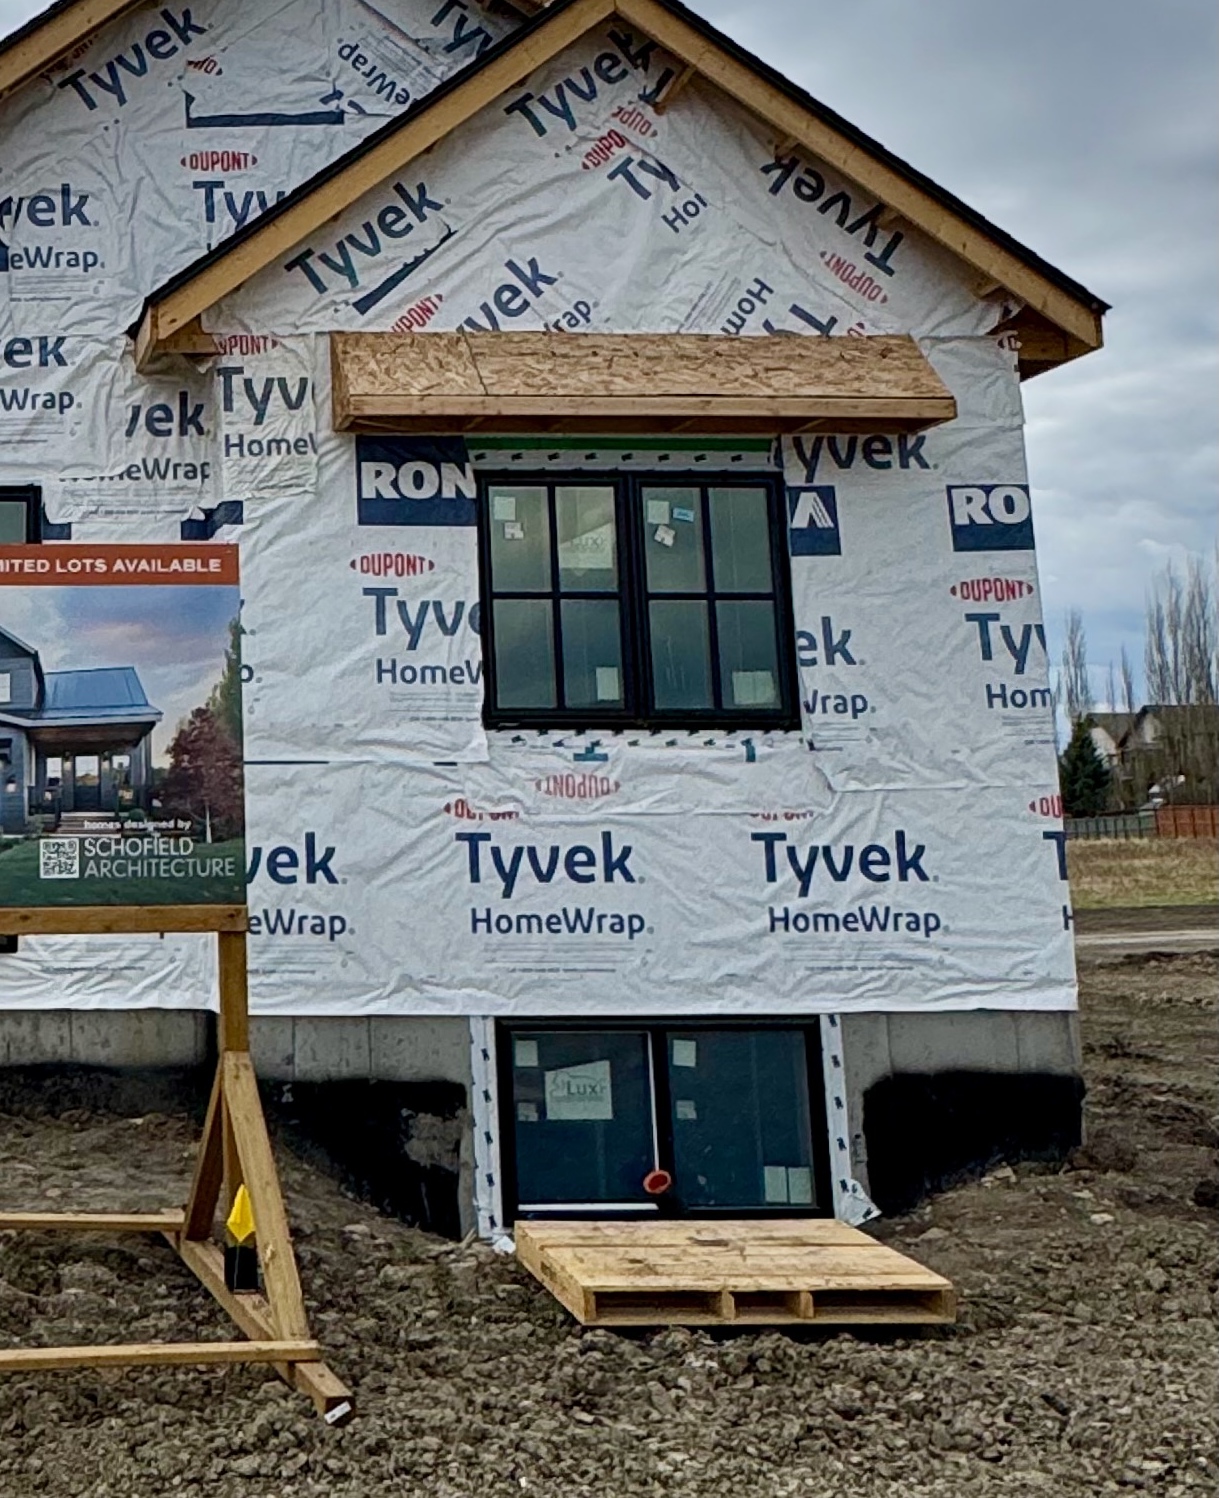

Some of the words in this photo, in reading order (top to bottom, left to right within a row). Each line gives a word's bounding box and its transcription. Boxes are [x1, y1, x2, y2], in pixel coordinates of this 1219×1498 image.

[58, 8, 208, 111] Tyvek
[504, 29, 646, 138] Tyvek
[190, 151, 249, 172] DUPONT
[760, 147, 904, 277] Tyvek
[284, 182, 444, 294] Tyvek
[824, 253, 883, 302] DUPONT
[456, 257, 558, 332] vek
[217, 366, 315, 426] Tyv
[55, 558, 107, 574] LOTS
[112, 558, 222, 574] AVAILABLE
[360, 553, 425, 577] DUPONT
[960, 578, 1025, 602] DUPONT
[544, 773, 611, 799] DUPONT
[123, 819, 175, 832] designed
[177, 819, 192, 831] by
[83, 836, 194, 857] SCHOFIELD
[83, 857, 236, 878] ARCHITECTURE
[455, 831, 636, 899] Tyvek
[751, 830, 930, 898] Tyvek
[470, 907, 646, 940] HomeWrap
[768, 905, 941, 938] HomeWrap
